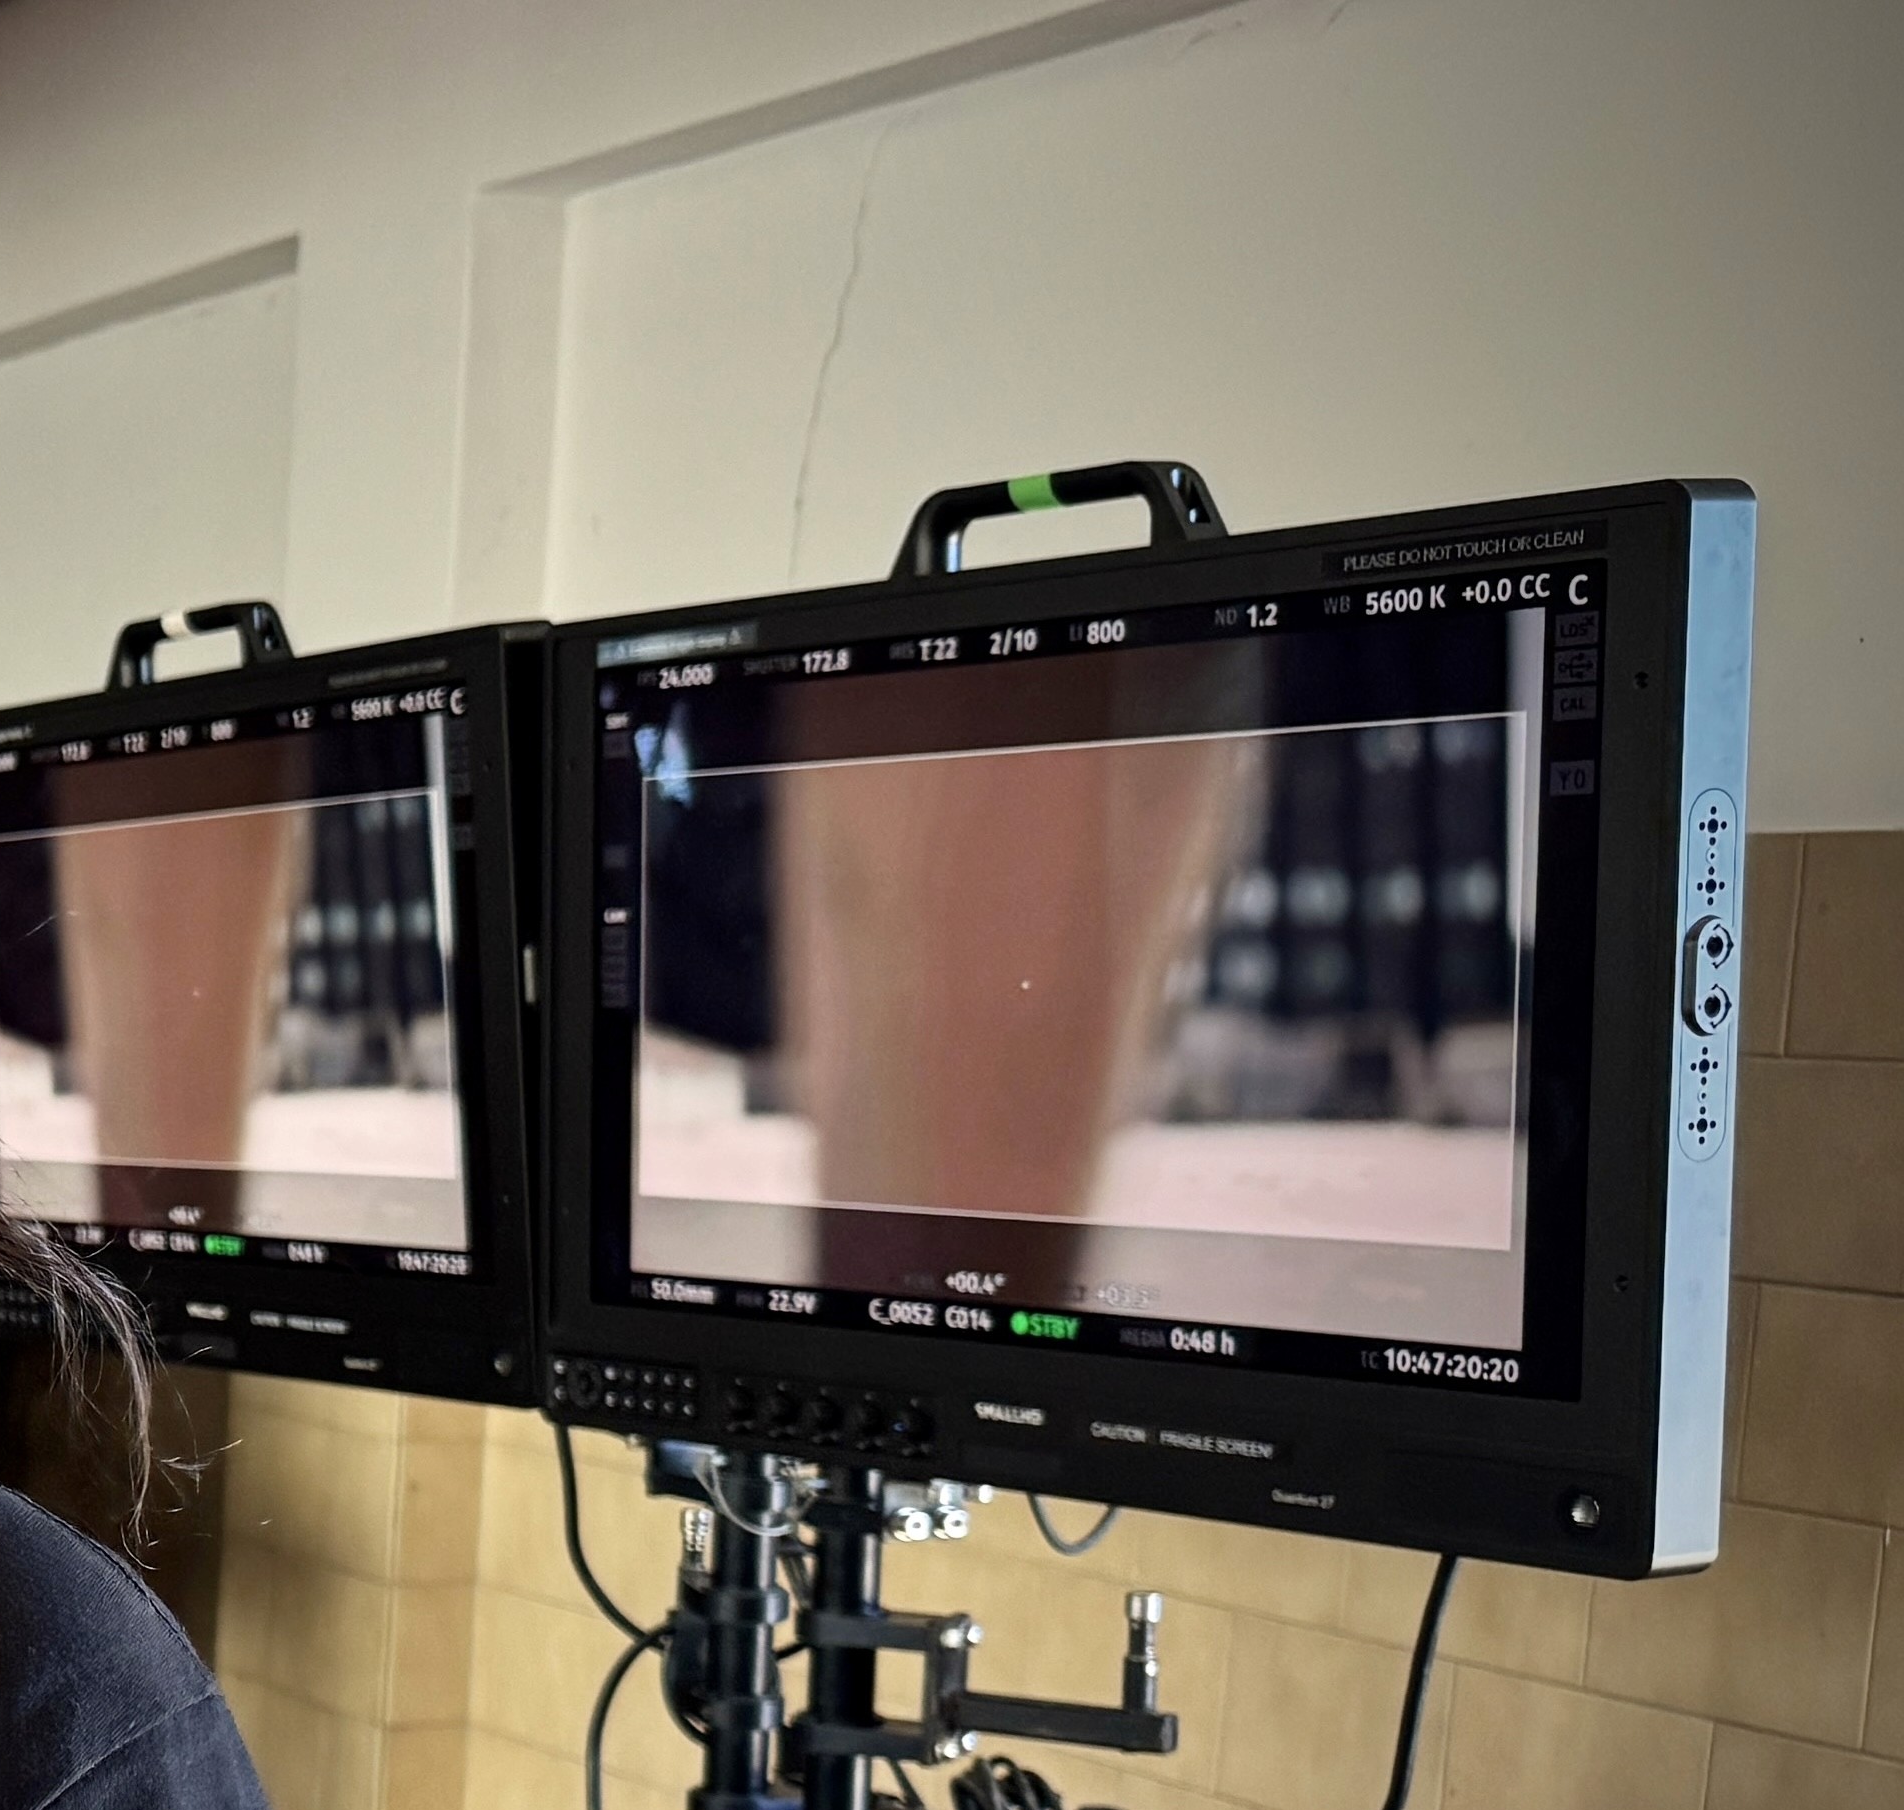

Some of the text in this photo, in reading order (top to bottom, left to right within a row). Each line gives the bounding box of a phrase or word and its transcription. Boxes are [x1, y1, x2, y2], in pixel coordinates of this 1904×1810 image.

[1343, 529, 1585, 572] PLEASE DO NOT TOUCH OR CLEAN
[989, 628, 1038, 655] 2/10
[1086, 618, 1126, 645] 800
[1246, 603, 1278, 628] 1.2
[1365, 587, 1423, 616] 5600
[1430, 584, 1446, 609] K
[1462, 578, 1512, 604] +0.0
[1519, 573, 1550, 600] CC
[1568, 574, 1589, 605] C
[1169, 1326, 1216, 1355] 0:48
[1221, 1330, 1236, 1357] h
[1383, 1348, 1520, 1384] 10:47:20:20
